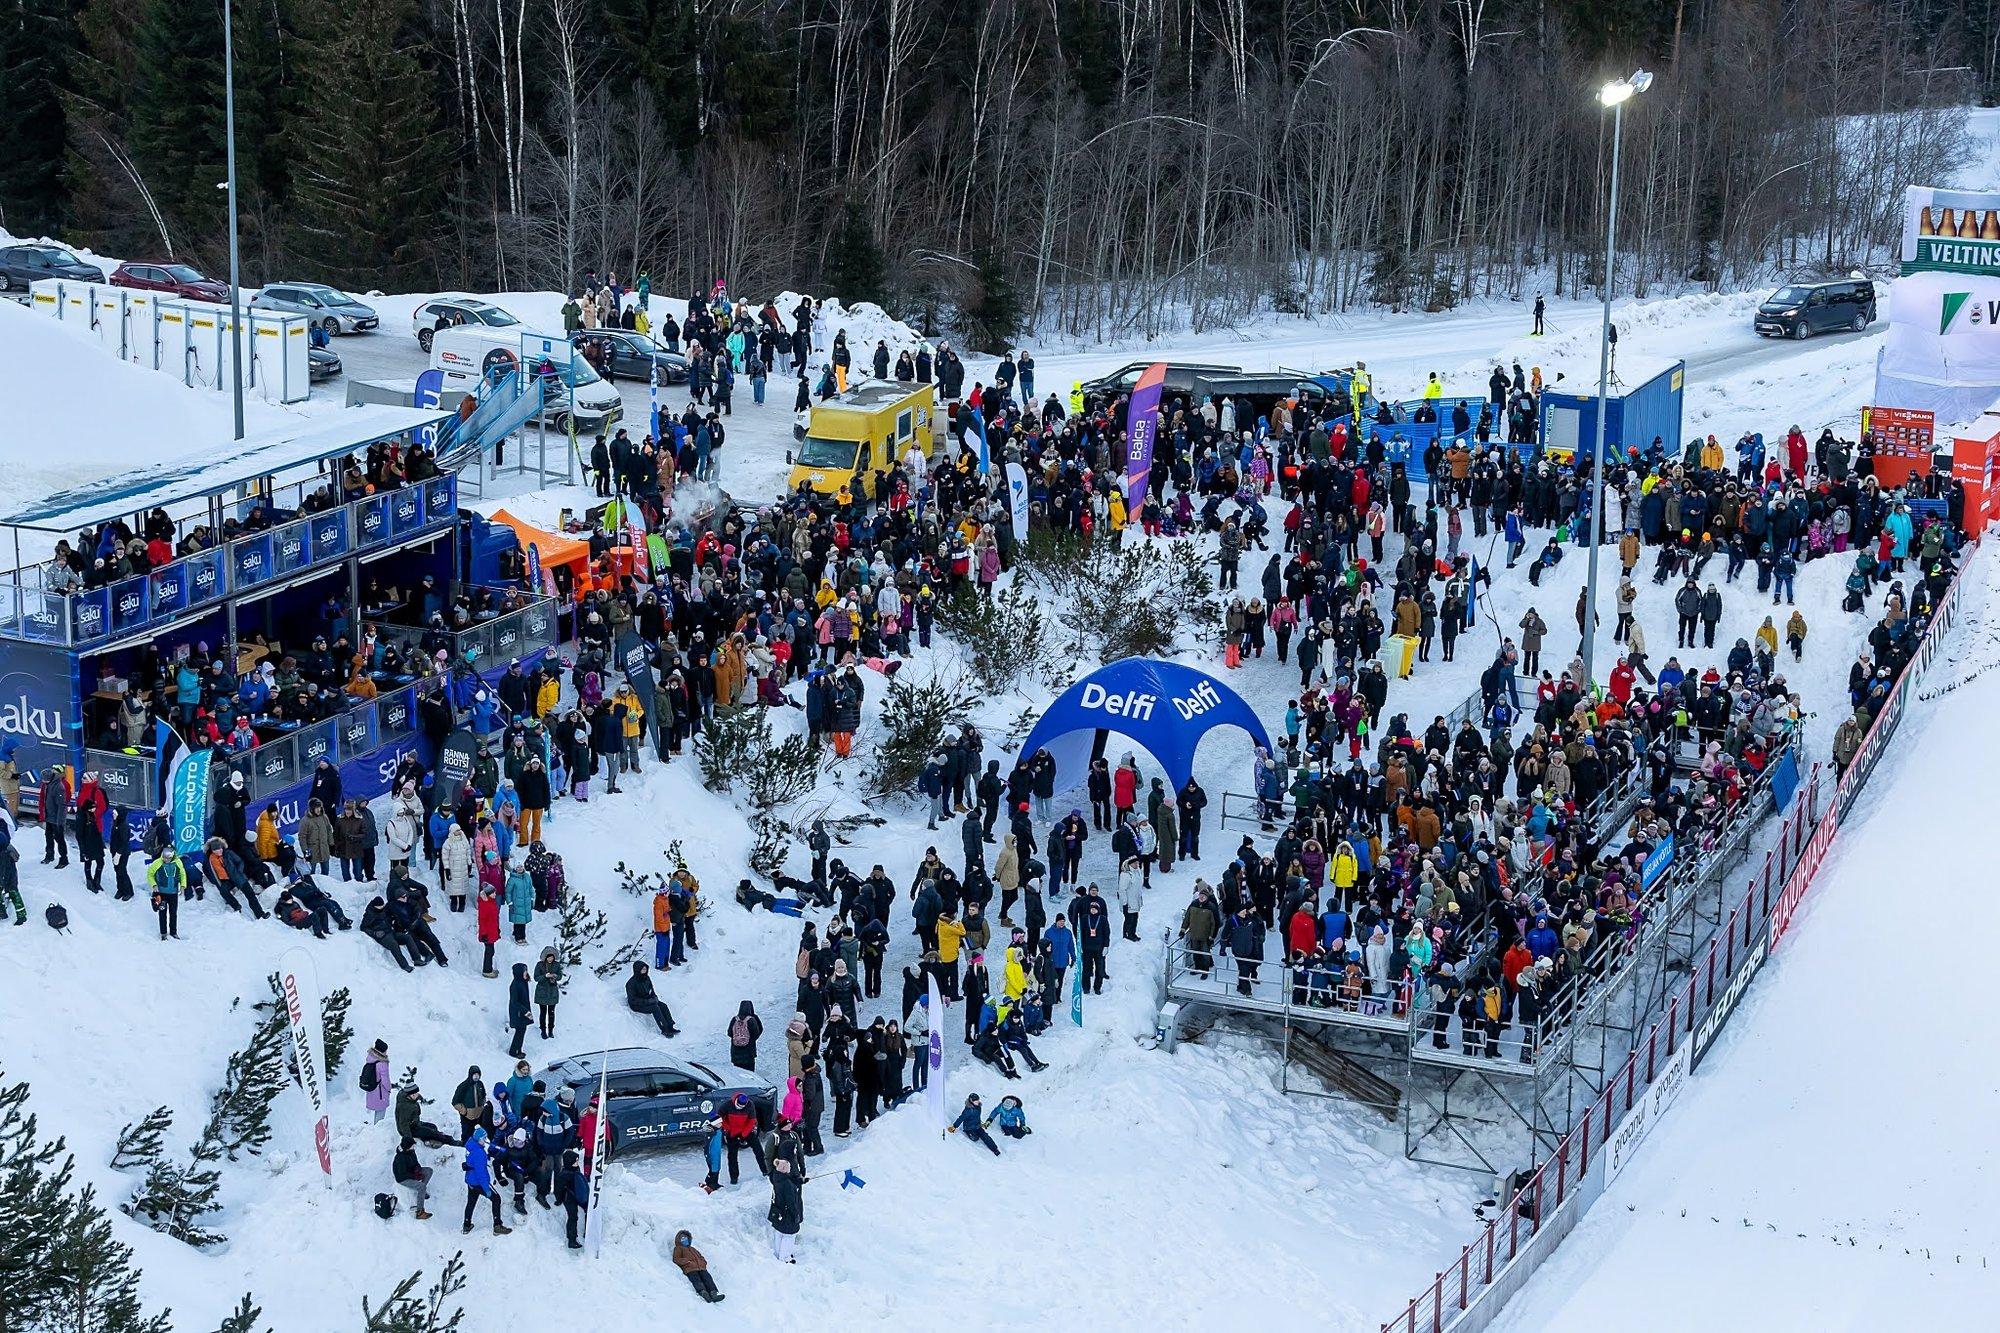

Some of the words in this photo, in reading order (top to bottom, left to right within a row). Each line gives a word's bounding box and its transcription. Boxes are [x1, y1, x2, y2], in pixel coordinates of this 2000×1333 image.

[1931, 243, 2000, 267] VELTINS
[422, 389, 442, 460] sau
[1130, 420, 1146, 461] Balcia
[432, 491, 448, 507] saku
[399, 502, 416, 517] saku
[364, 513, 381, 530] saku
[320, 528, 338, 544] saku
[283, 538, 301, 557] saku
[243, 552, 262, 571] saku
[196, 570, 216, 586] saku
[158, 581, 178, 599] saku
[119, 596, 140, 613] saku
[33, 611, 58, 626] saku
[80, 608, 101, 625] saku
[499, 630, 516, 647] saku
[1080, 682, 1157, 721] Delfi
[1171, 679, 1222, 721] Delfi
[0, 694, 63, 740] aku
[388, 705, 406, 723] saku
[348, 724, 366, 741] saku
[308, 740, 326, 758] saku
[265, 757, 284, 775] saku
[443, 756, 469, 769] ROOTSI
[103, 771, 129, 786] saku
[185, 762, 198, 823] CFMOTO
[1771, 804, 1837, 943] BAUHAUS
[1694, 934, 1767, 1060] SKECHERS
